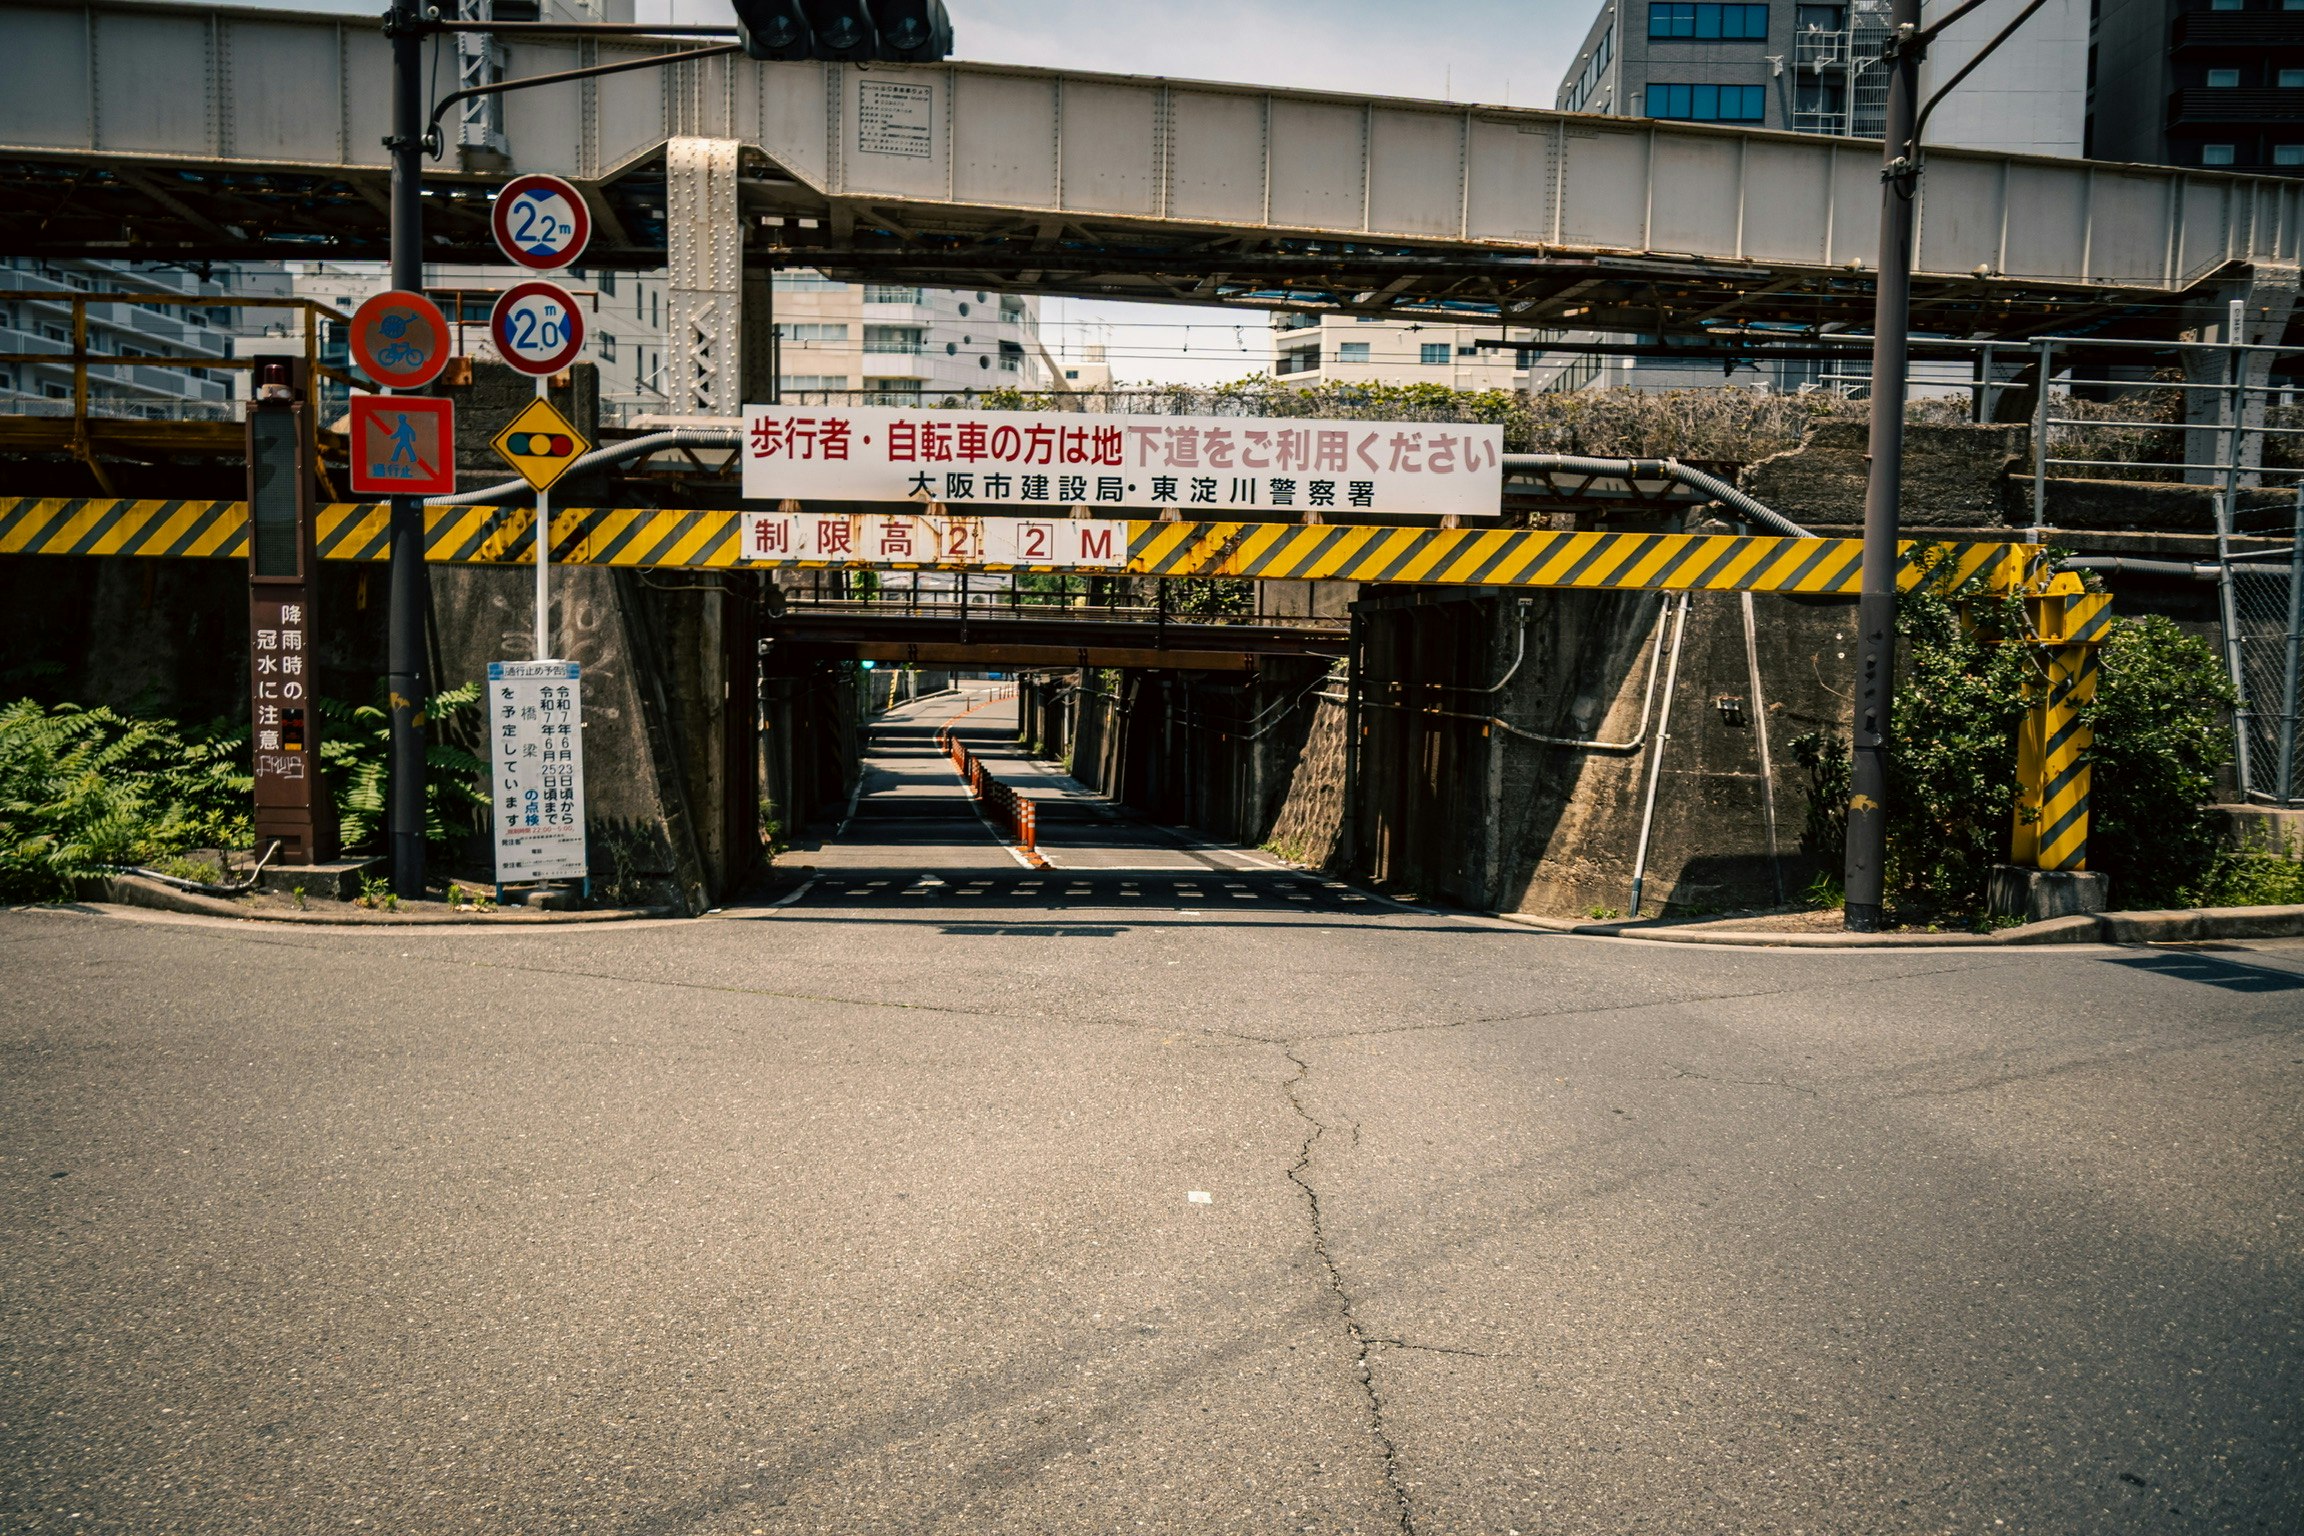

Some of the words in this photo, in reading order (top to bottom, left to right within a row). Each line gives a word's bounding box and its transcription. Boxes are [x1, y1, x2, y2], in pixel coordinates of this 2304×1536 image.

[513, 200, 571, 243] 2.2m
[750, 415, 1498, 475] 歩行者・自転車の方は地下道をご利用ください
[908, 470, 1376, 508] 大阪市建設局・東淀川警察署
[257, 629, 279, 750] 冠水に注意
[281, 604, 303, 700] 降雨時の
[501, 687, 519, 827] を予定しています
[540, 686, 558, 825] 令和7年6月25日頃まで
[556, 686, 575, 825] 令和7年6月23日頃から
